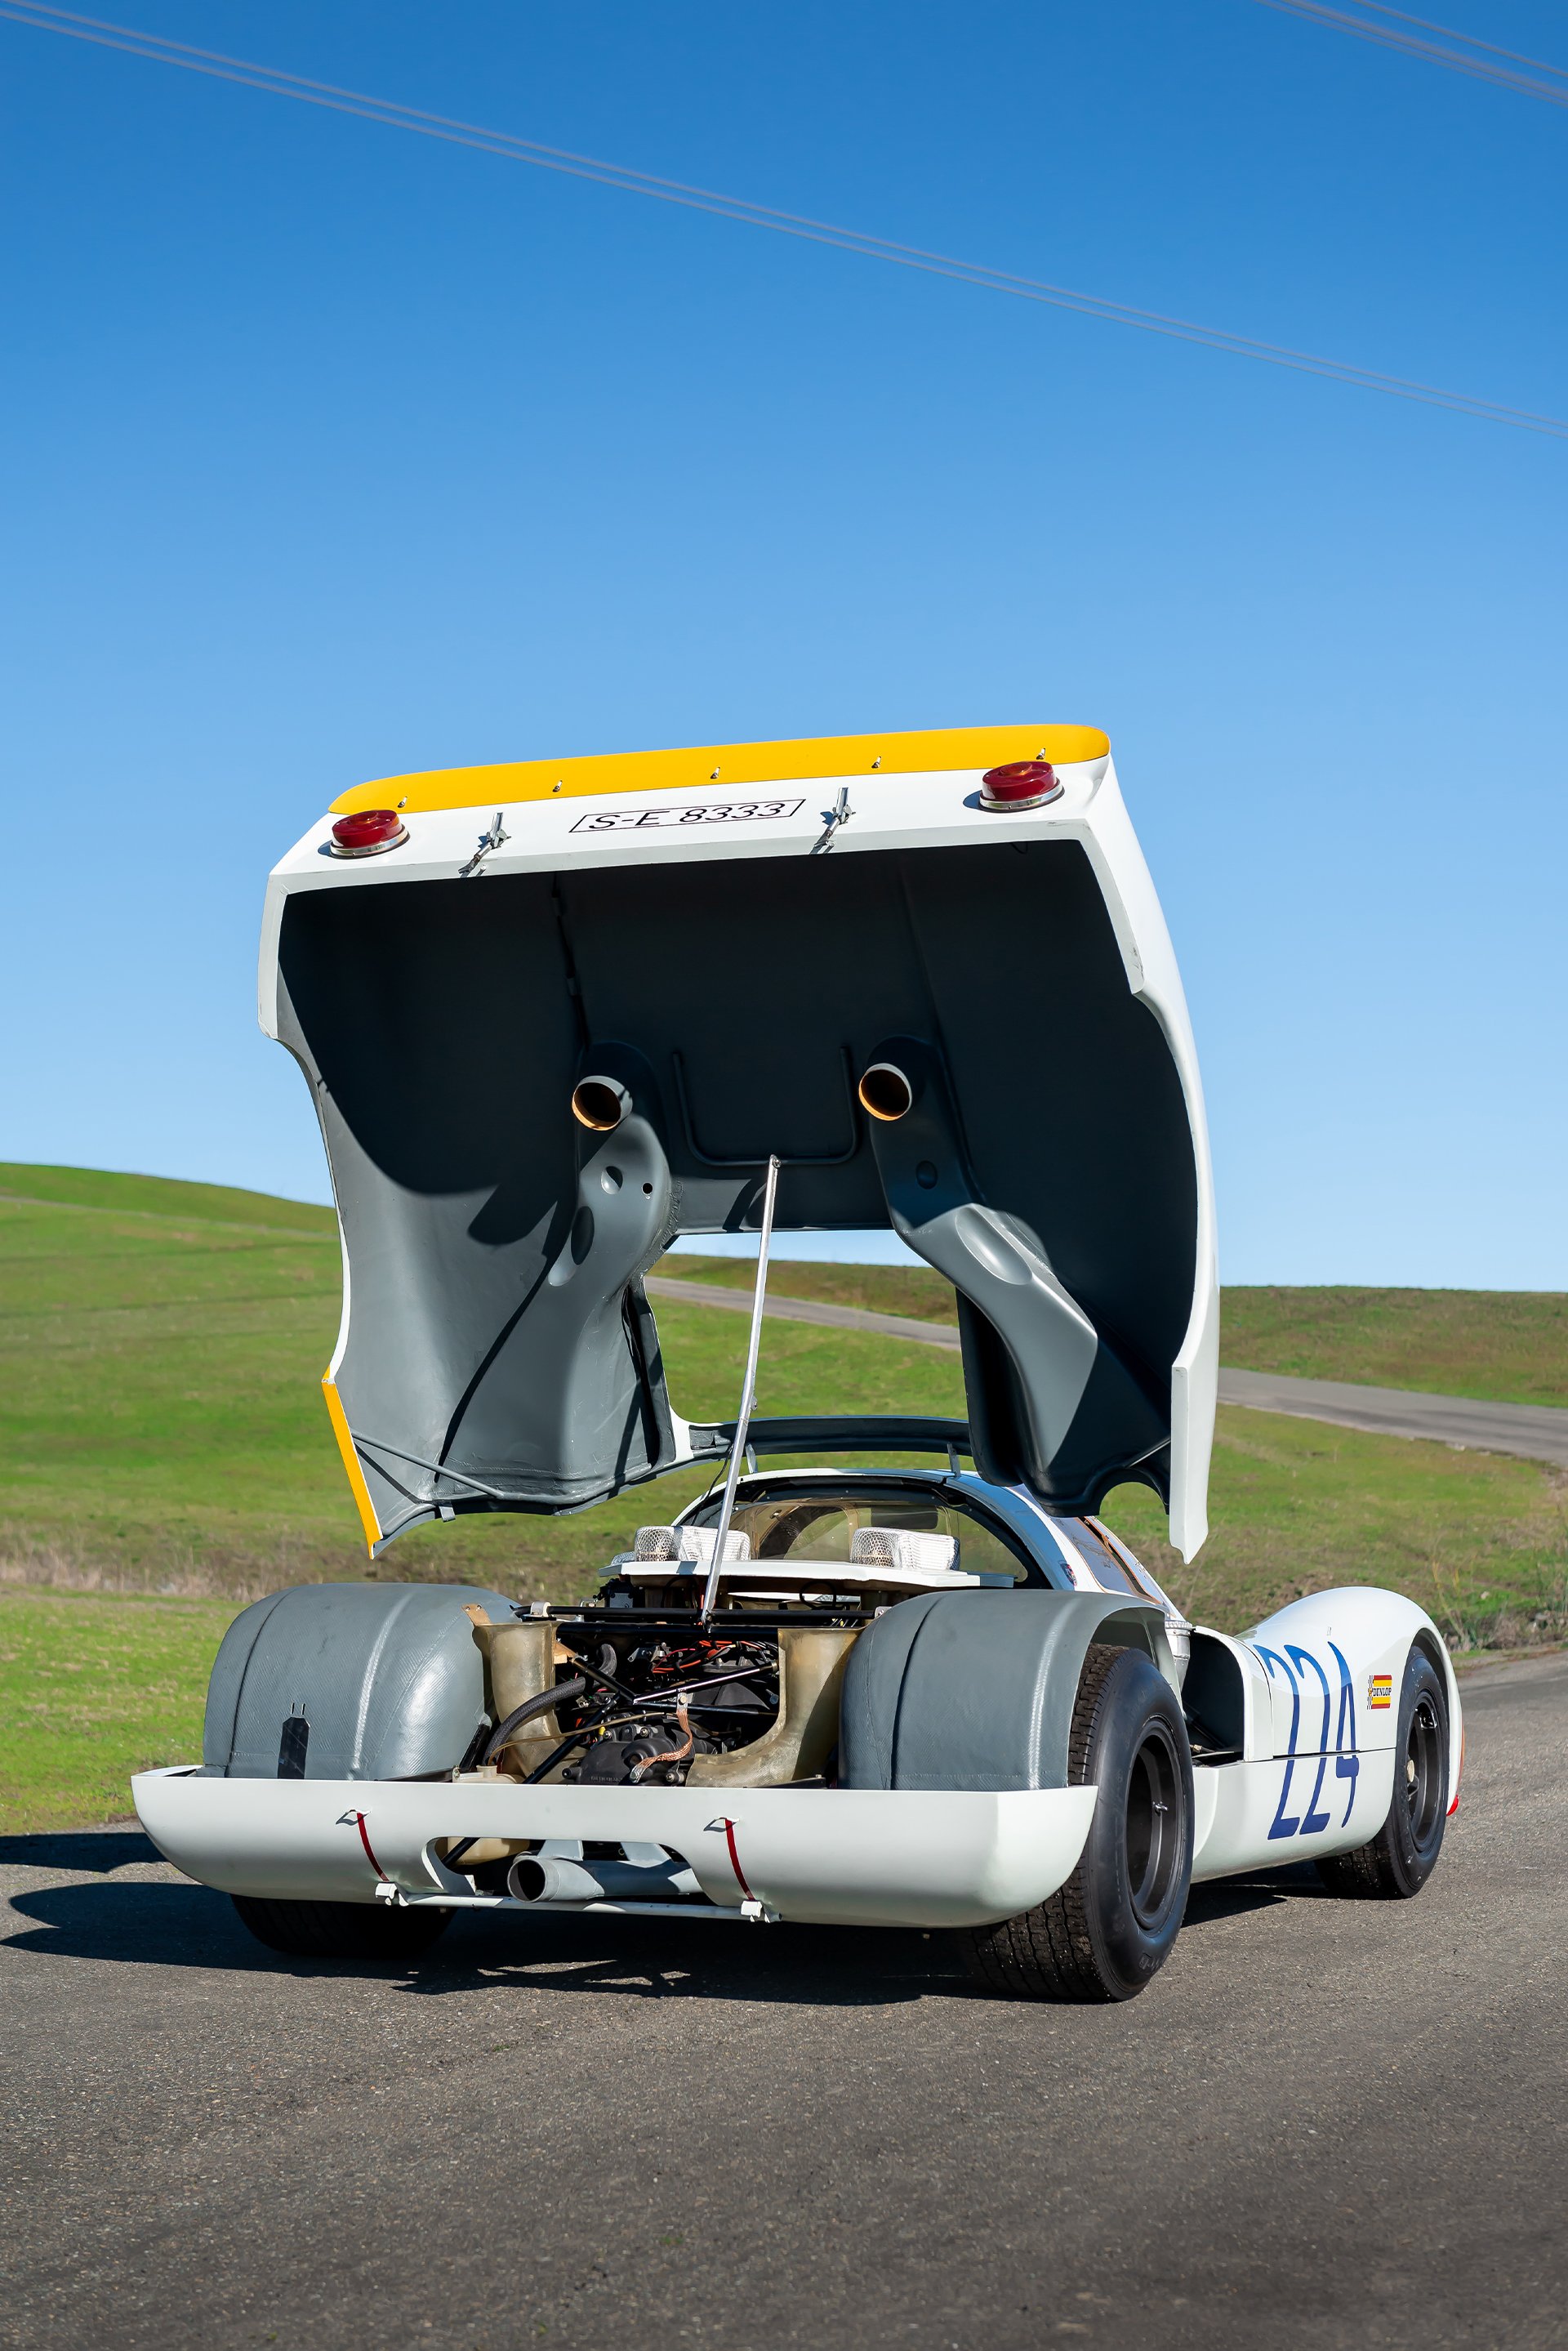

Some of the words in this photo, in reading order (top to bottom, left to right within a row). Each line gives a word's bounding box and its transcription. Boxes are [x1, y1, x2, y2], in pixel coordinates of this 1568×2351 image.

[589, 810, 670, 829] S-E
[679, 802, 786, 823] 8333
[1373, 1687, 1392, 1697] DUNLOP
[1253, 1641, 1359, 1840] 224
